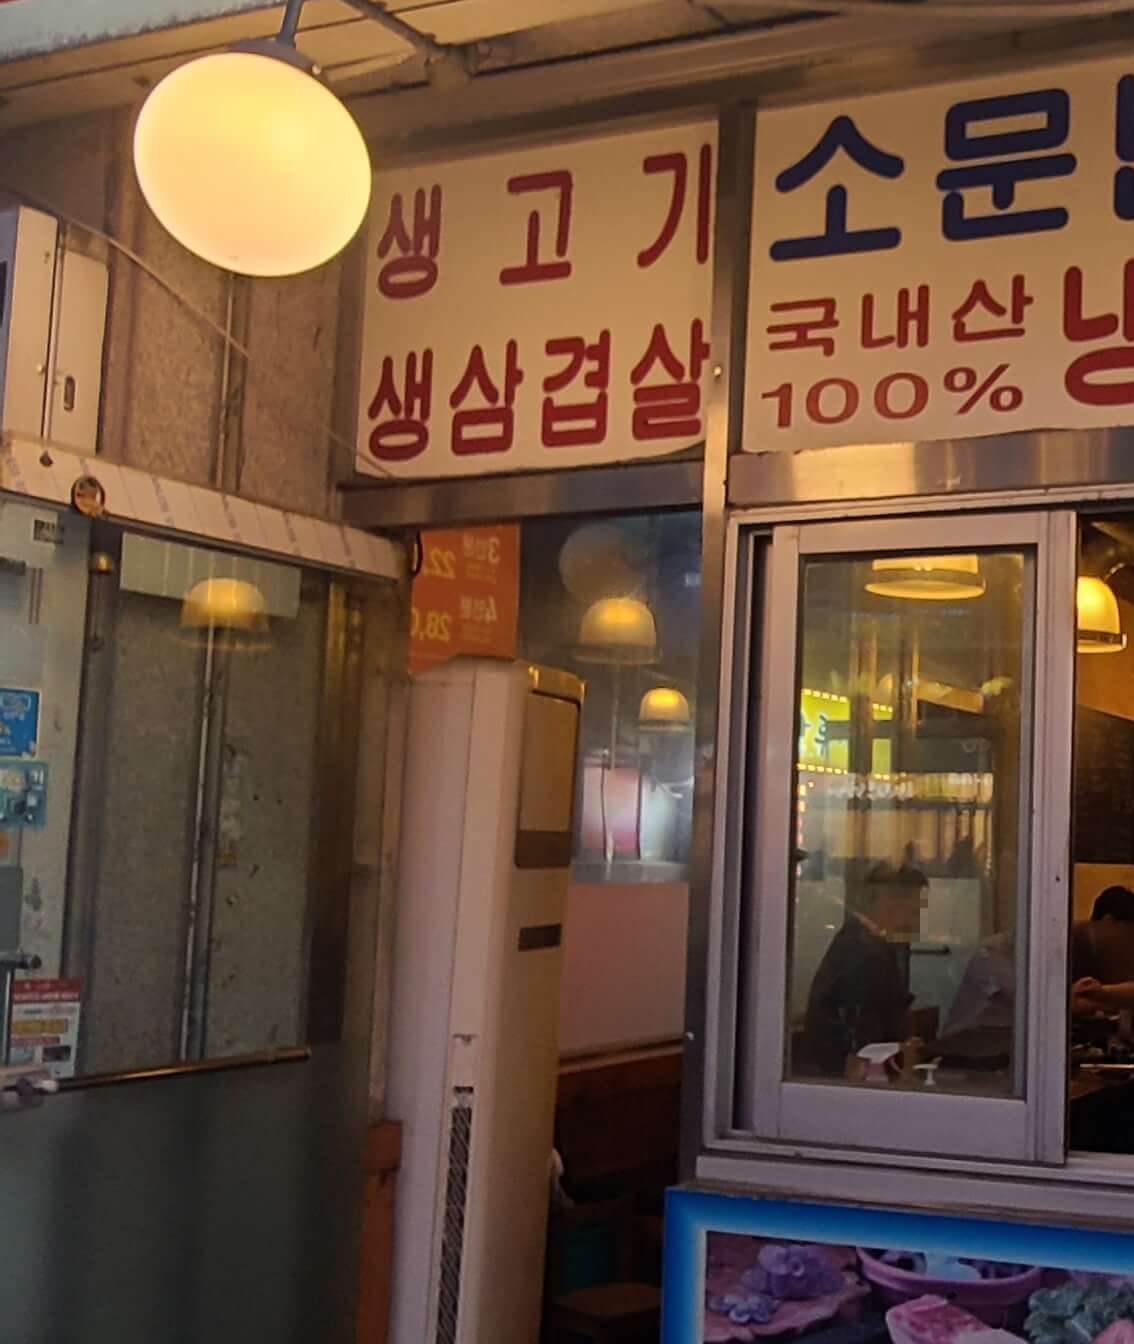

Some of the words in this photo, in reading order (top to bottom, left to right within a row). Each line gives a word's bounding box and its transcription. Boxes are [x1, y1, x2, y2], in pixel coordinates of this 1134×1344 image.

[766, 275, 1033, 357] 국내산
[367, 318, 711, 462] 생삼겹살
[761, 363, 1024, 429] 100%
